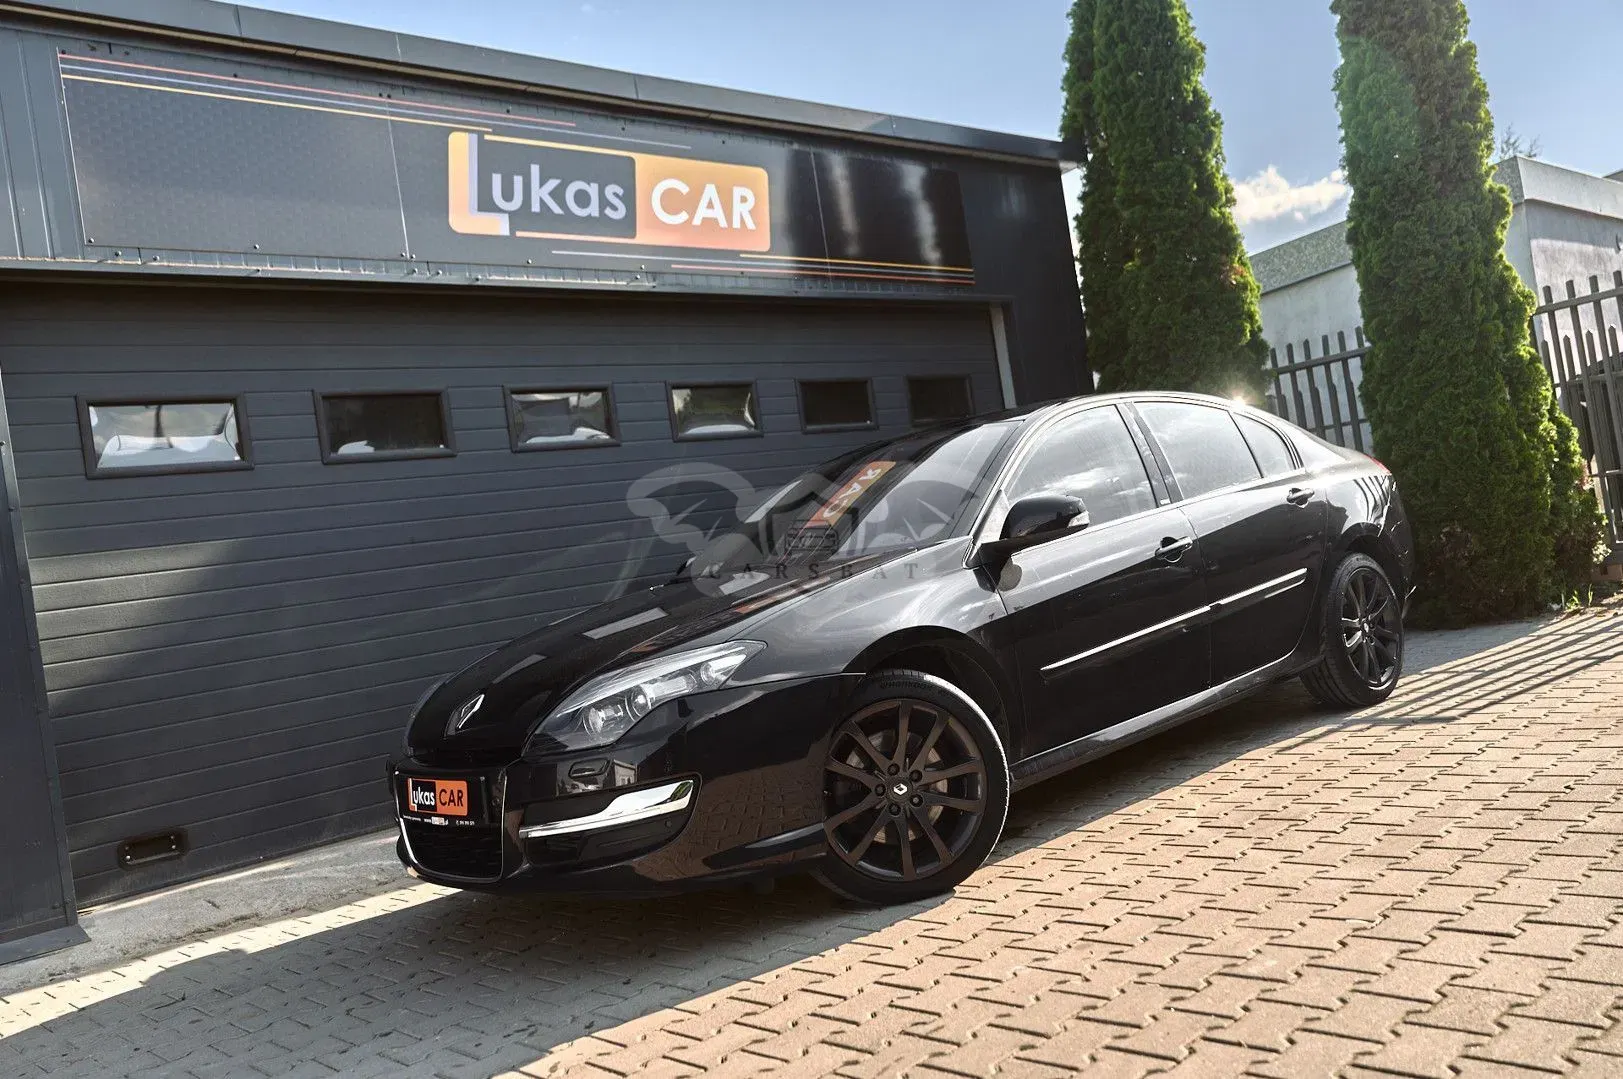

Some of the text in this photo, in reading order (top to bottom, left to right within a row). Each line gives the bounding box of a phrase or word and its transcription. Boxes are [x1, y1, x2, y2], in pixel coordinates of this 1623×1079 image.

[448, 131, 757, 236] Lukas CAR
[408, 778, 464, 812] Lukas CAR
